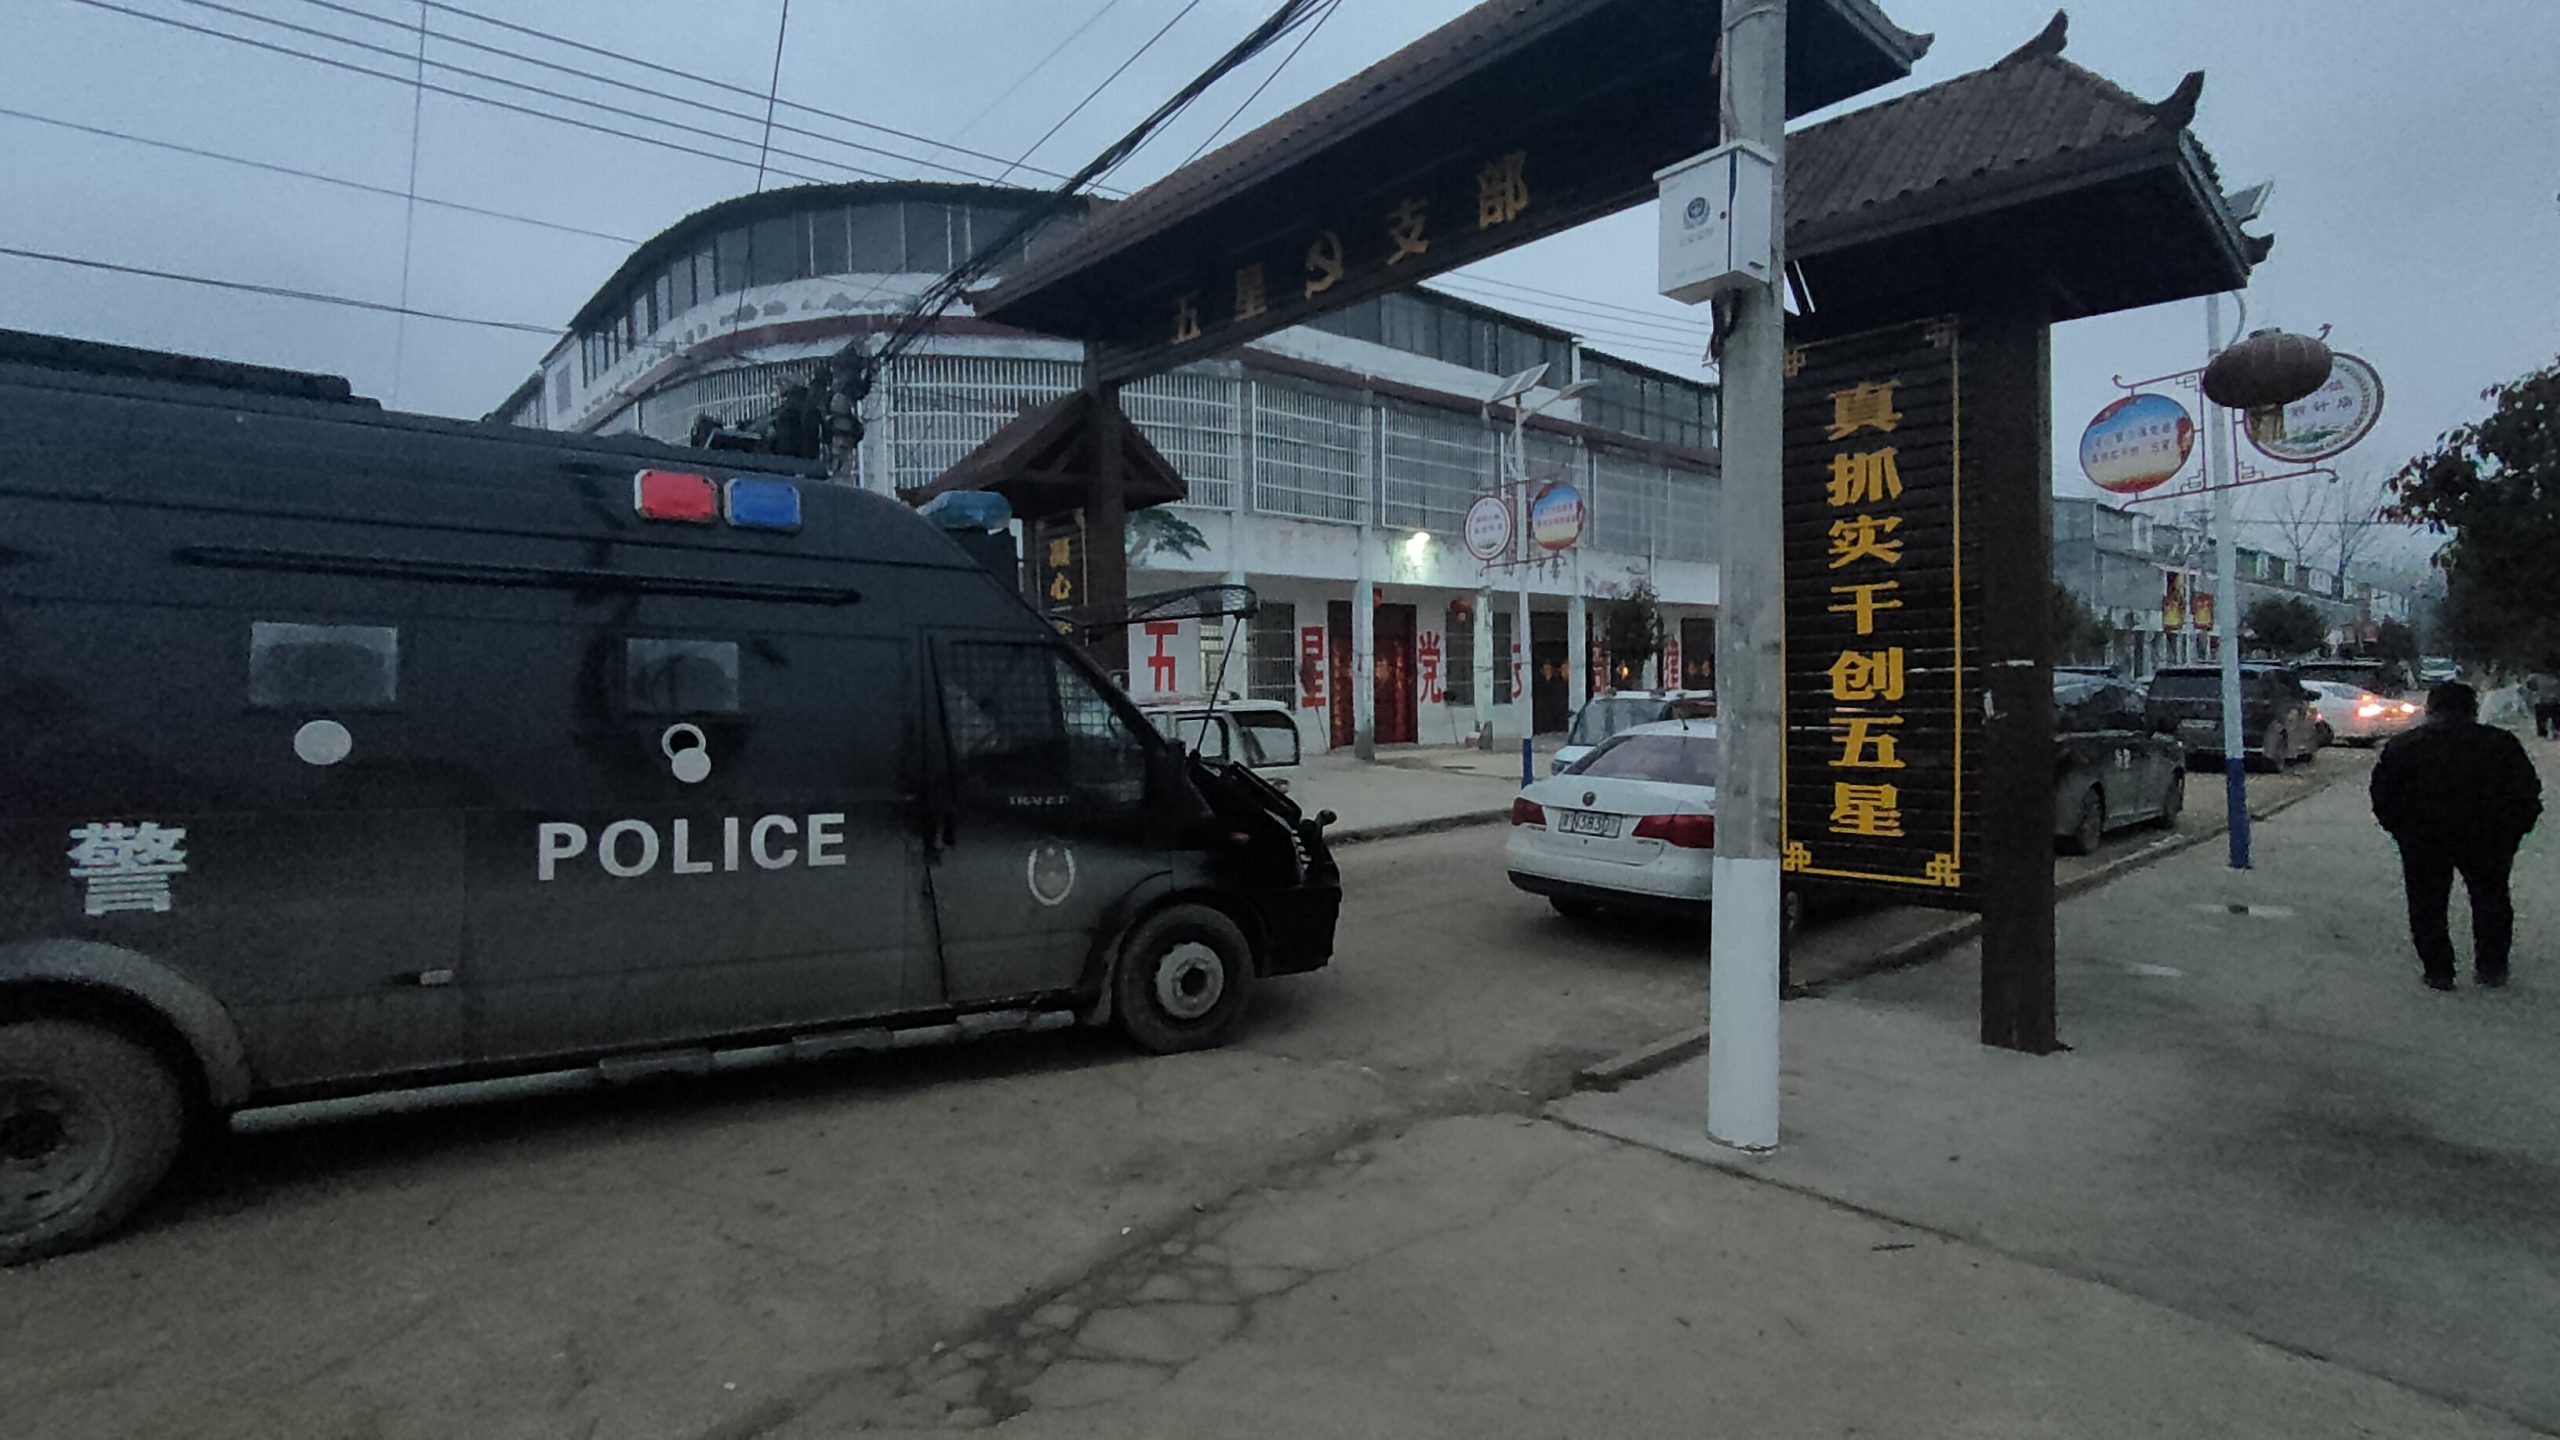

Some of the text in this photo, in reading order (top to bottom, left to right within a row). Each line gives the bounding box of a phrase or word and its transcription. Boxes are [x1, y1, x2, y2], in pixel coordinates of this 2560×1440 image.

[1825, 379, 1905, 837] 真抓实干创五星
[66, 821, 188, 916] 警
[538, 813, 846, 881] POLICE
